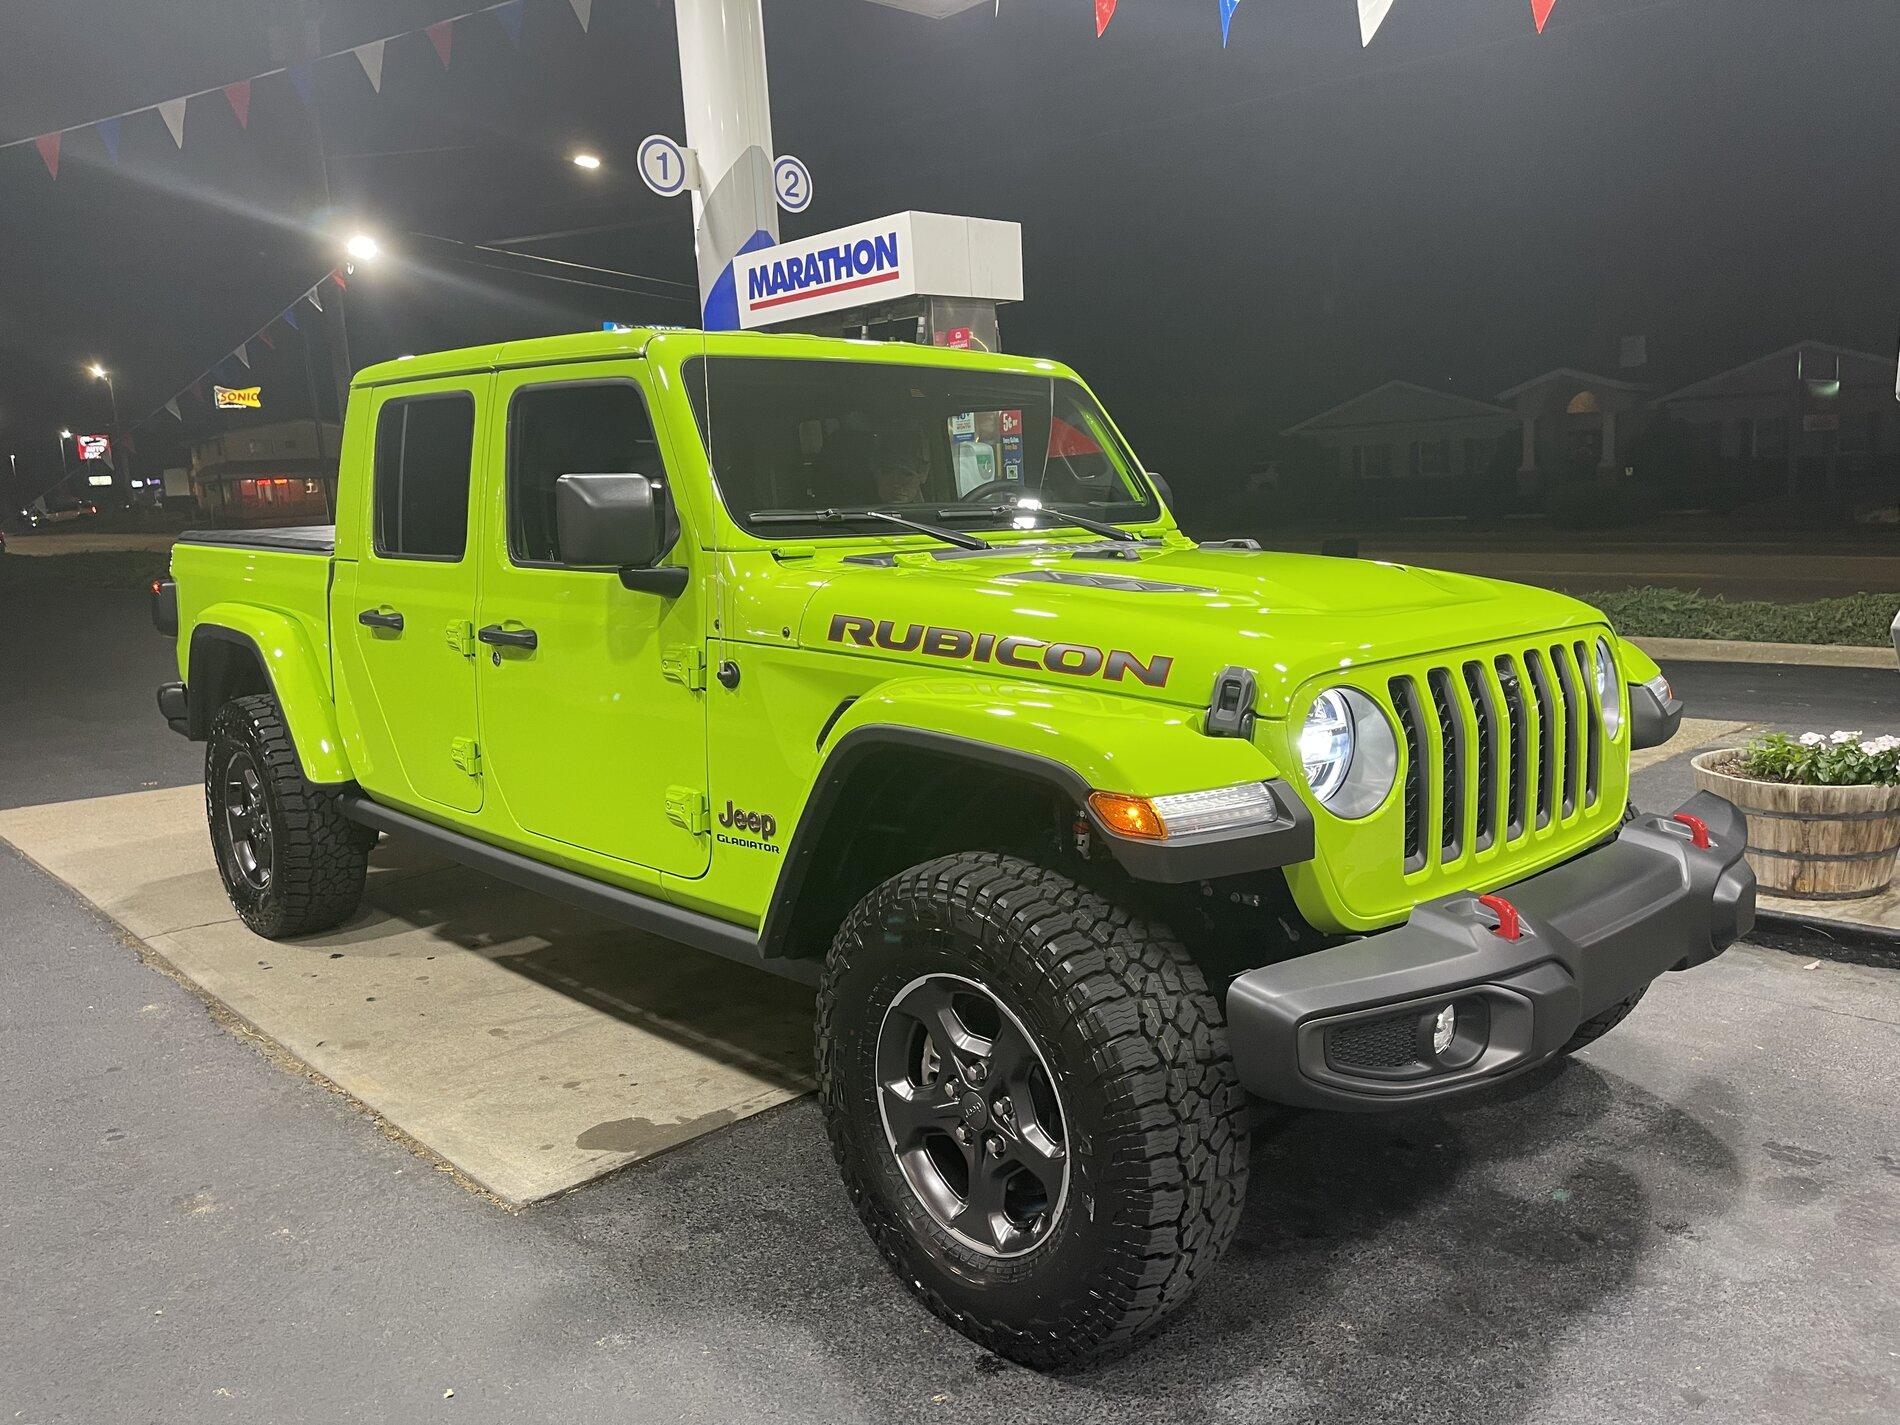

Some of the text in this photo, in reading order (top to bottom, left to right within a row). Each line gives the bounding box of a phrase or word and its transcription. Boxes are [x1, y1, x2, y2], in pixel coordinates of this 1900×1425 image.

[656, 152, 669, 180] 1
[785, 171, 799, 197] 2
[748, 231, 899, 299] MARATHON
[220, 392, 257, 402] SONIC
[827, 614, 1175, 688] RUBICON
[718, 800, 776, 839] Jeep
[716, 833, 780, 854] GLADIATOR
